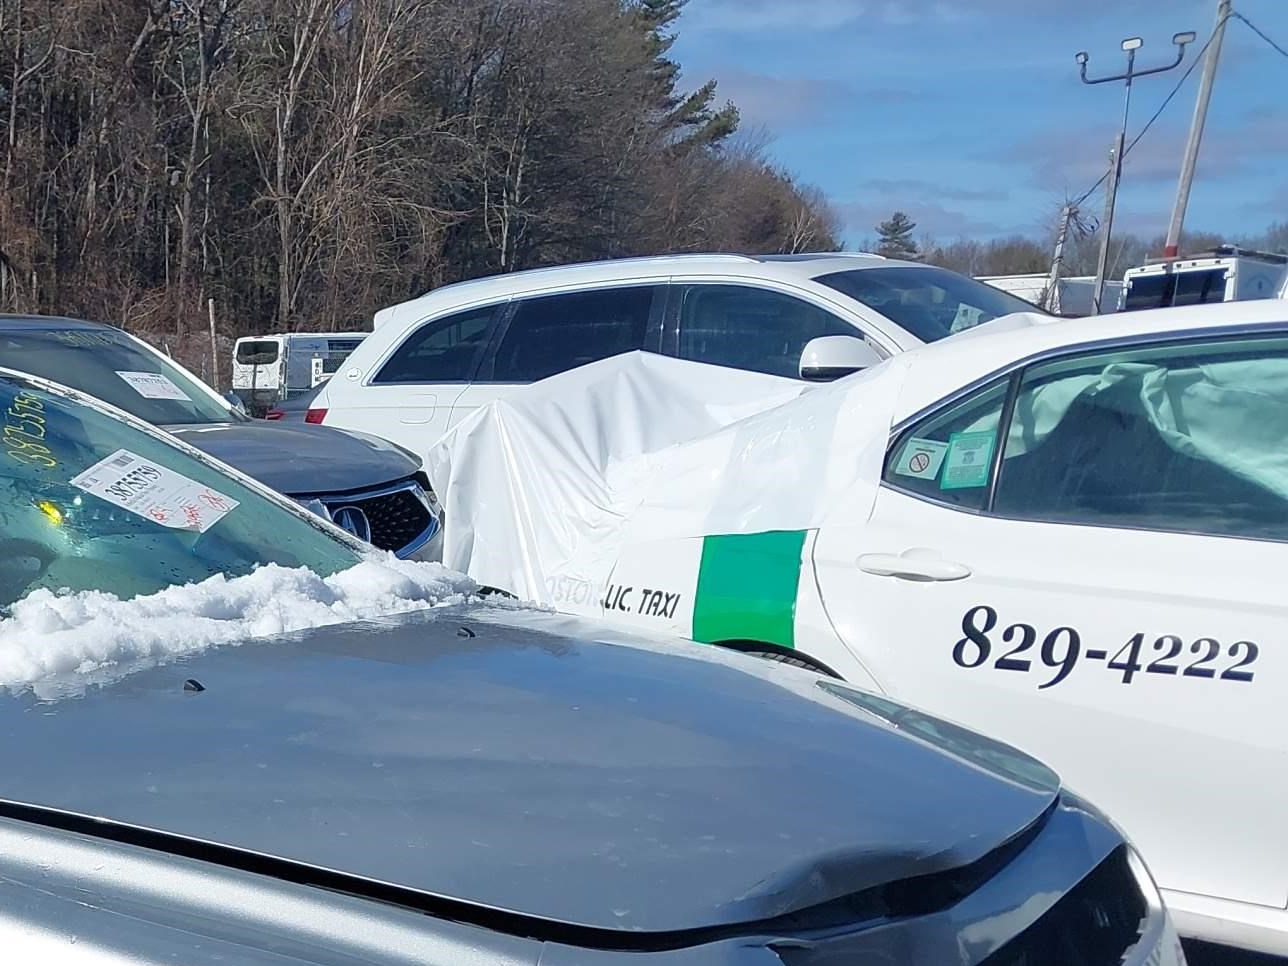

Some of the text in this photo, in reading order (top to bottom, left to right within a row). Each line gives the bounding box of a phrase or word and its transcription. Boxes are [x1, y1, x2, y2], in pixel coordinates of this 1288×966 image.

[104, 465, 162, 501] 38755759
[604, 584, 633, 613] LIC.
[638, 588, 681, 619] TAXI
[952, 604, 1260, 690] 829-4222
